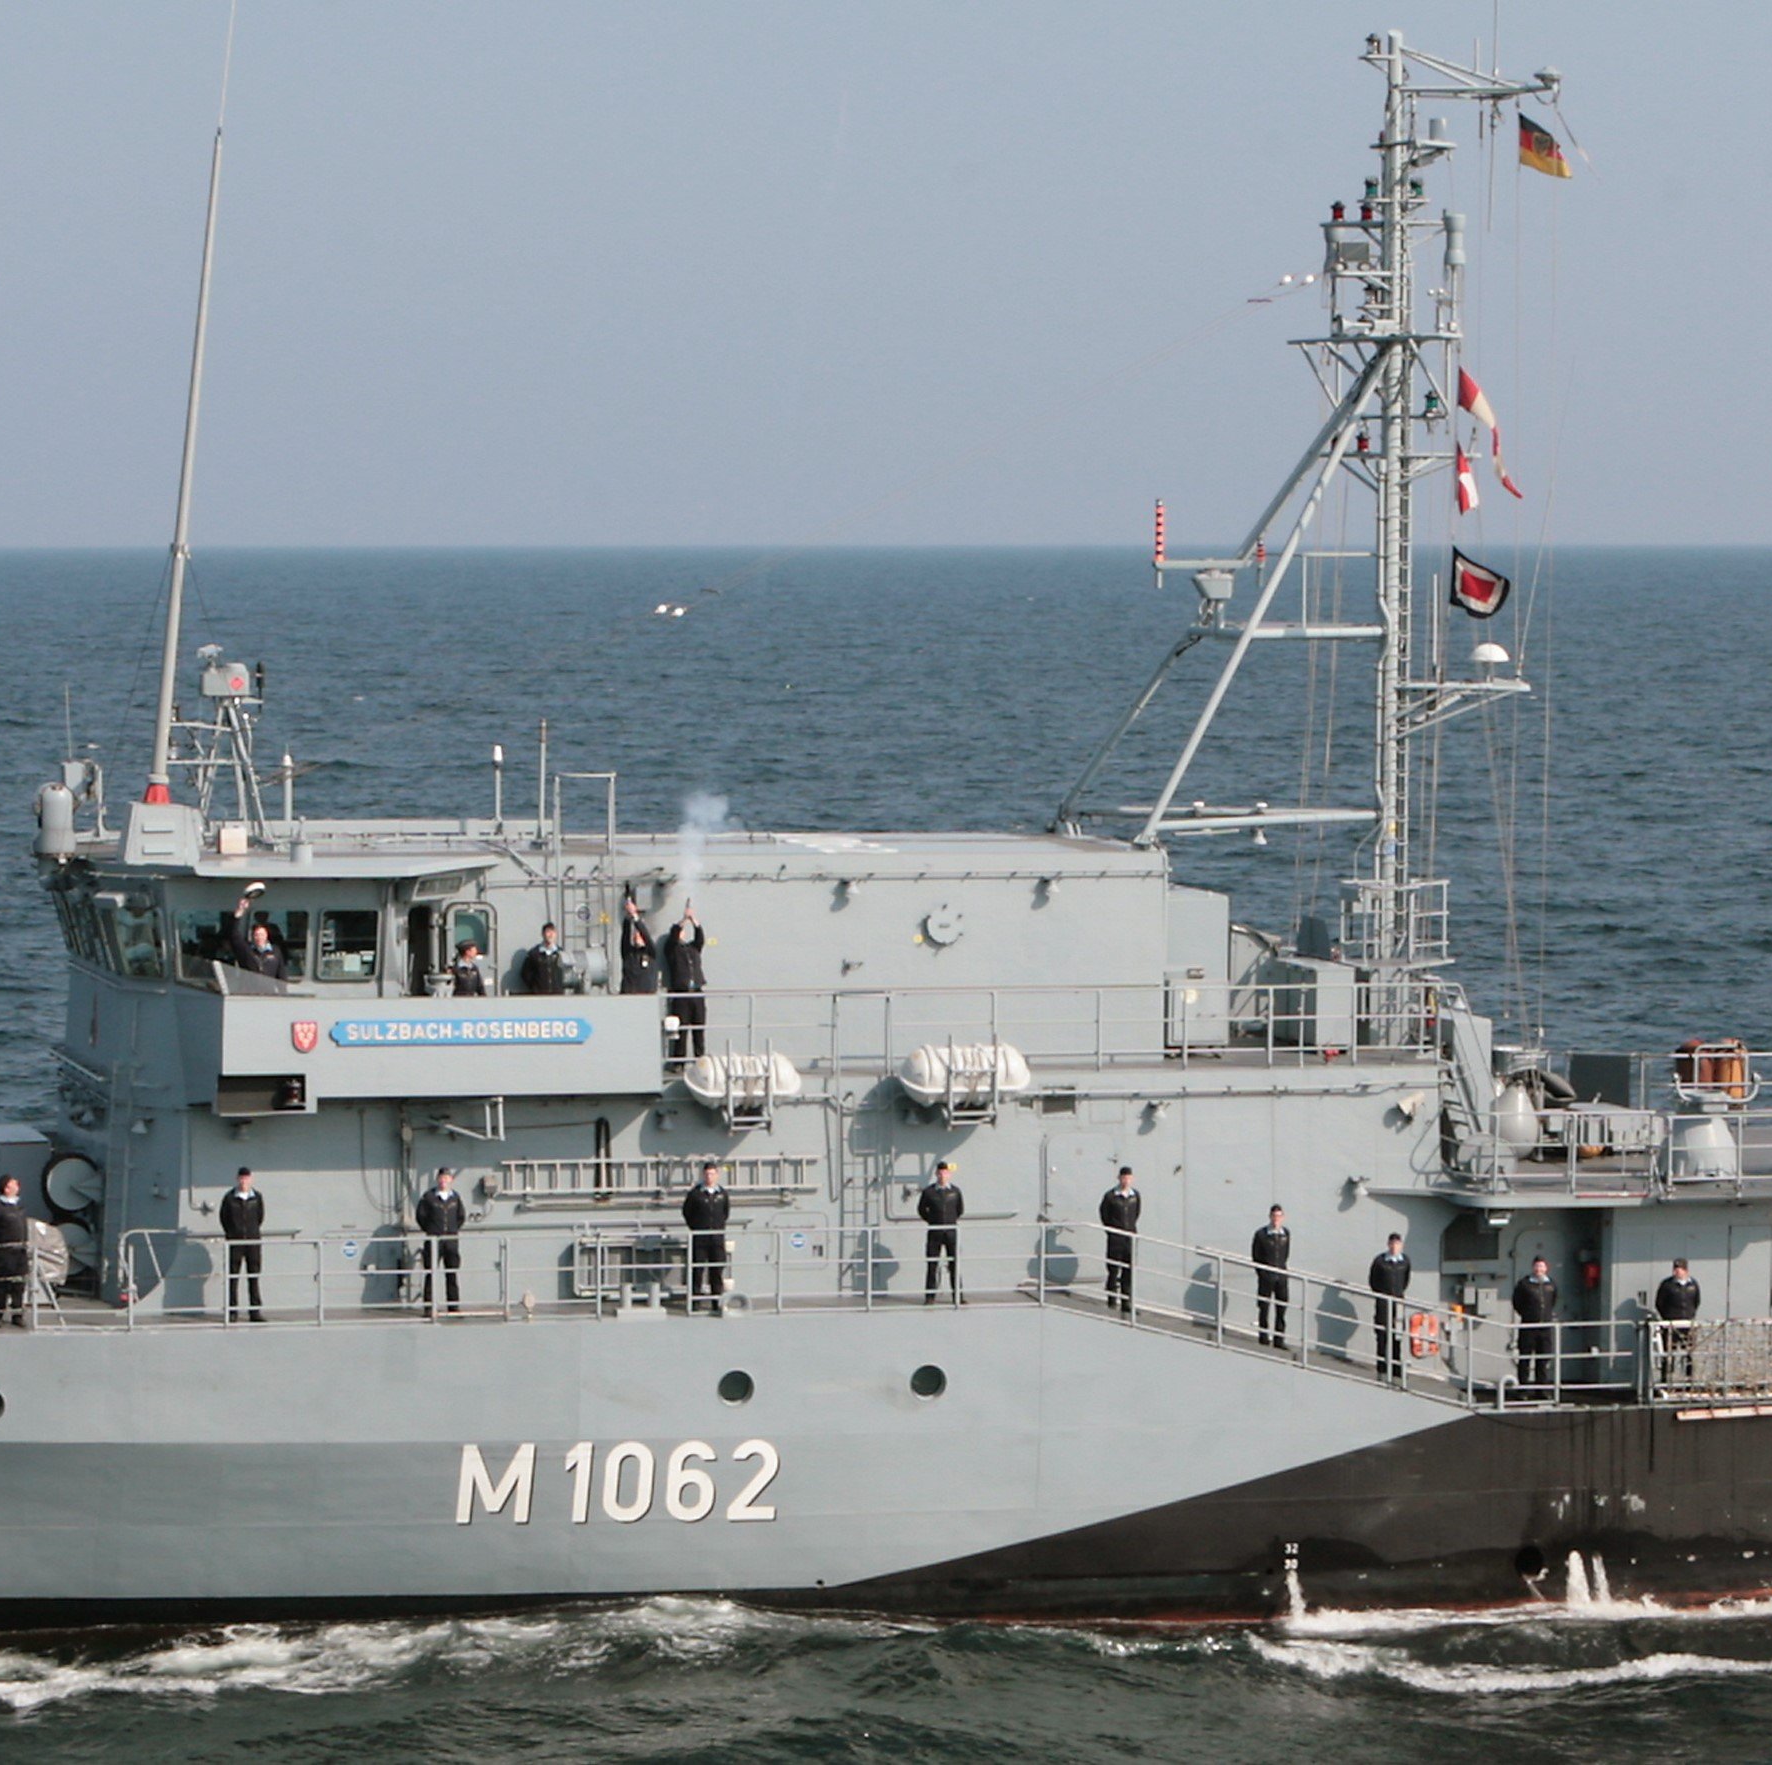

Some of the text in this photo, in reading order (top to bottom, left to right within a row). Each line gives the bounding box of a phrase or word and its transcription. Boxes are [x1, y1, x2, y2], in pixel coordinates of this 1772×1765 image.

[346, 1020, 578, 1041] SULZBACH-ROSENBERG
[456, 1439, 780, 1525] M 1062
[1284, 1542, 1299, 1555] 32
